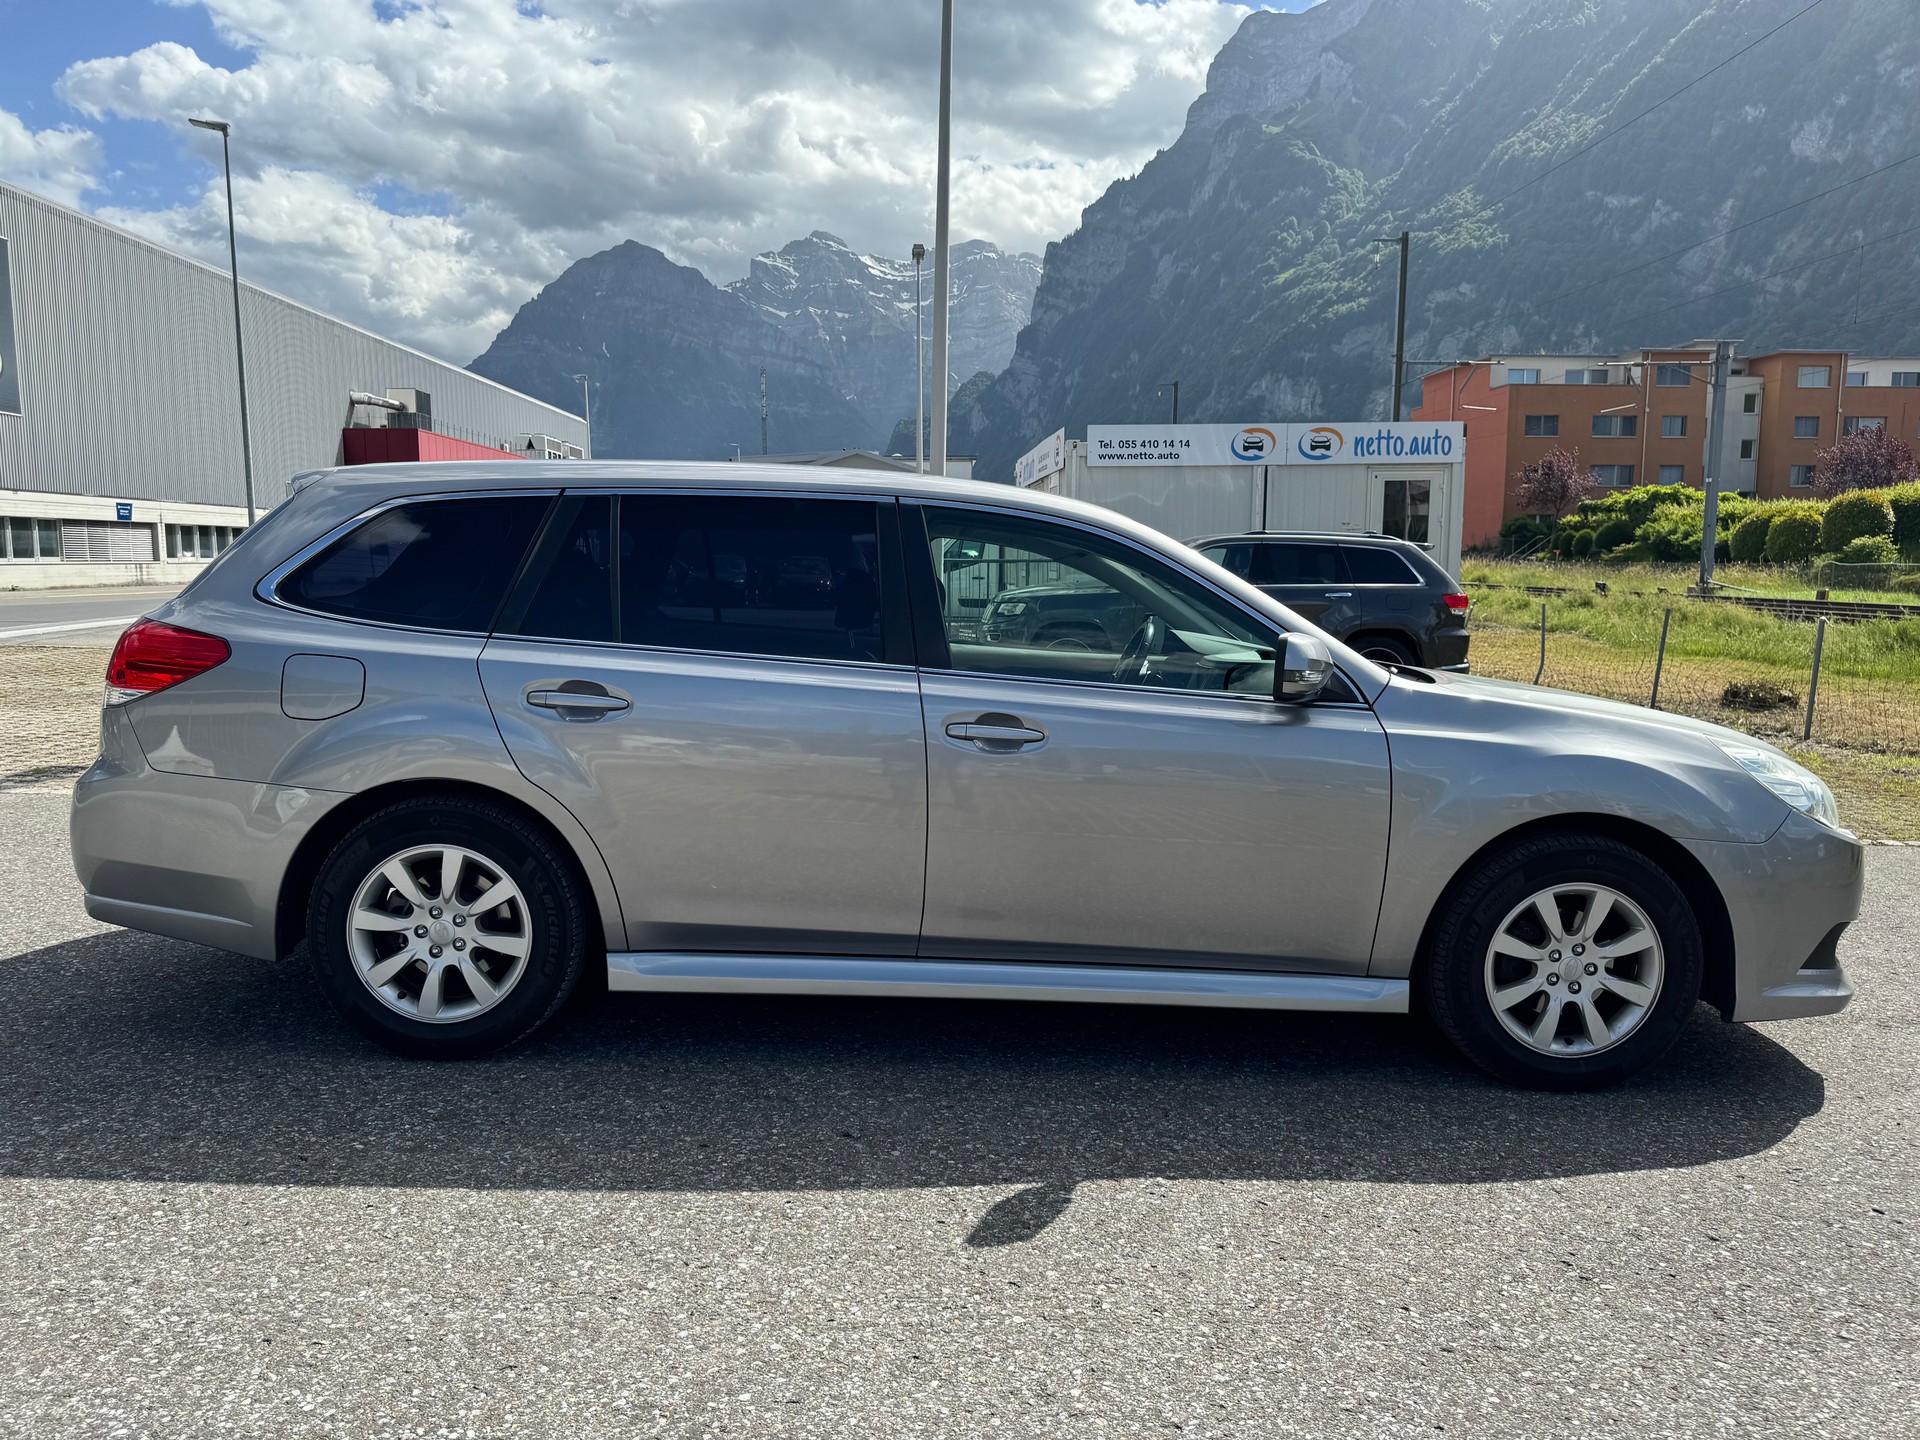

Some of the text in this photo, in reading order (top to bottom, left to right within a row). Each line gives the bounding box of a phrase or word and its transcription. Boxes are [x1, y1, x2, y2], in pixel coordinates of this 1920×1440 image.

[1098, 439, 1191, 449] Tel. 055 410 14 14
[1098, 451, 1180, 460] www.netto.auto
[1353, 428, 1453, 457] netto.auto
[316, 892, 334, 976] MICHELIN
[541, 894, 560, 976] MICHELIN
